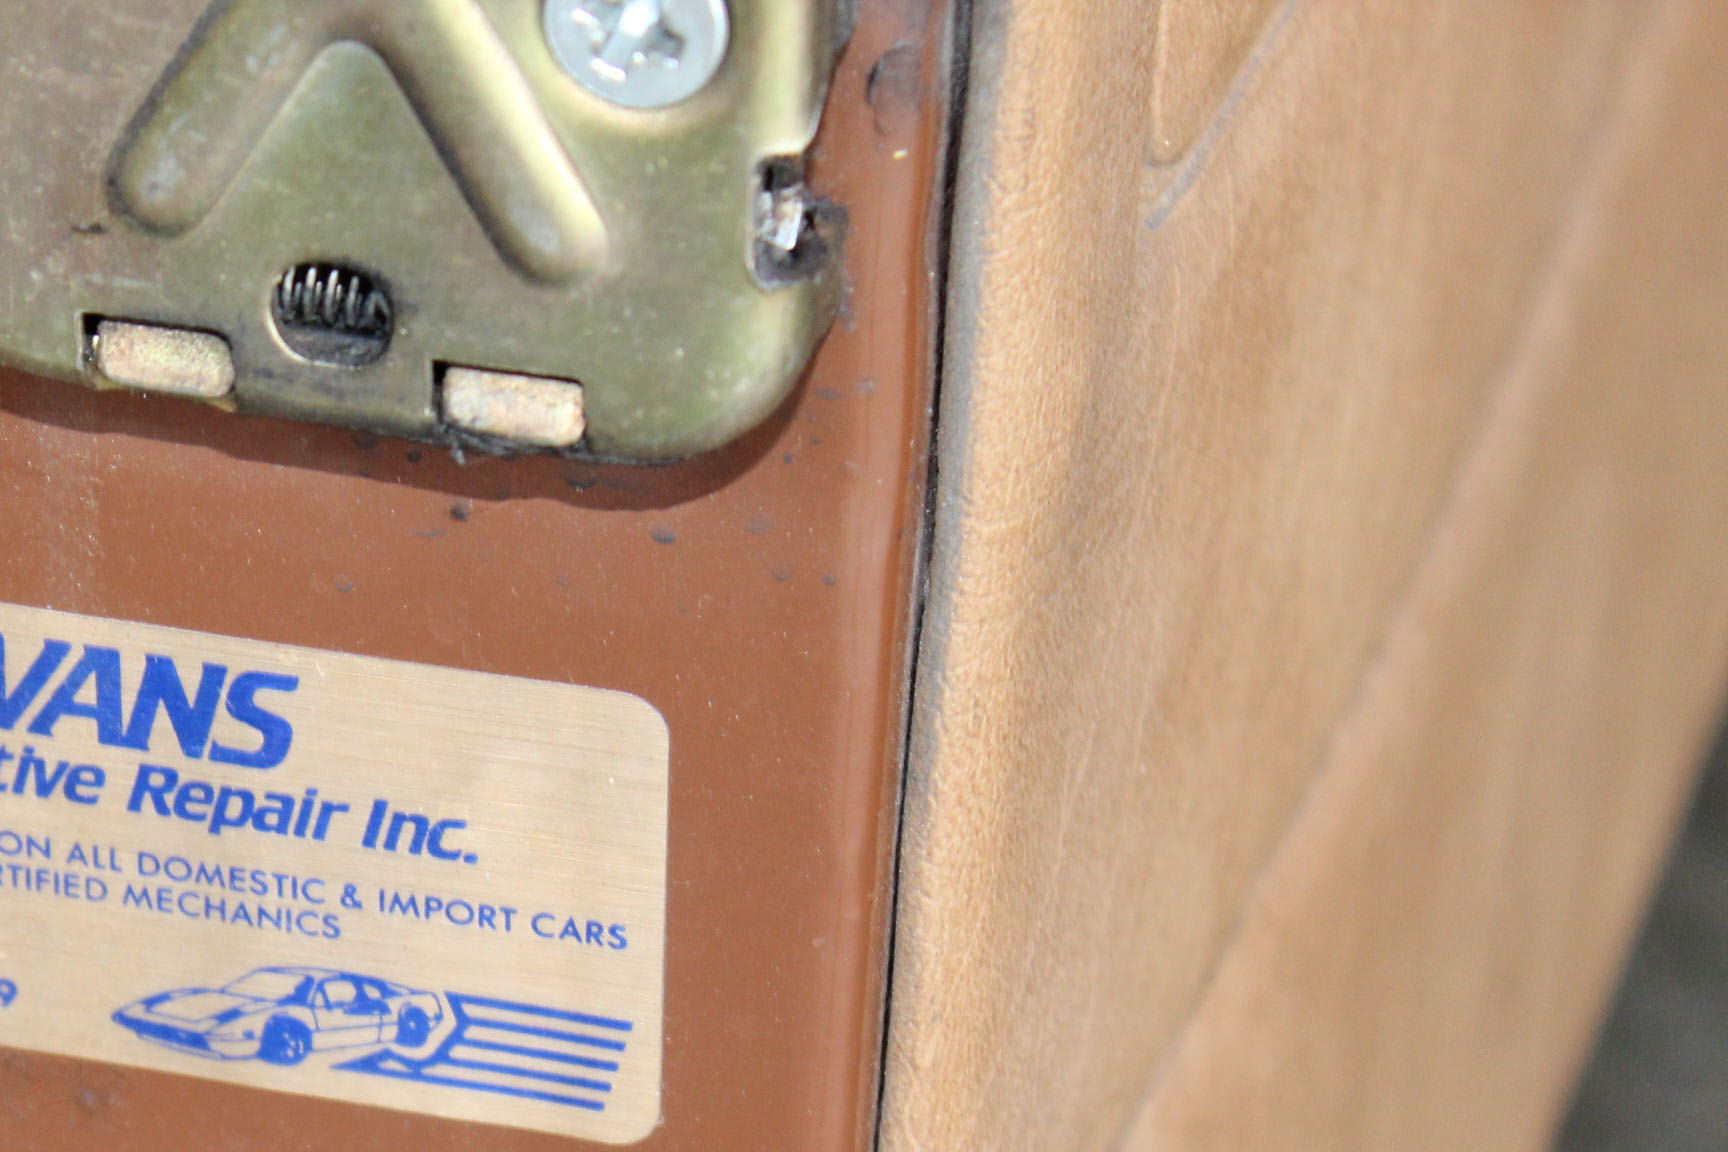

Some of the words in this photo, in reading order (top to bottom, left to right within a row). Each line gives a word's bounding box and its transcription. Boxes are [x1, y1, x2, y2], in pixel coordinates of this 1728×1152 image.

[126, 763, 349, 841] Repair
[361, 798, 479, 864] Inc.
[66, 842, 123, 873] ALL
[137, 852, 326, 903] DOMESTIC
[340, 883, 363, 909] &
[379, 889, 517, 932] IMPORT
[531, 912, 628, 950] CARS
[123, 884, 341, 939] MECHANICS
